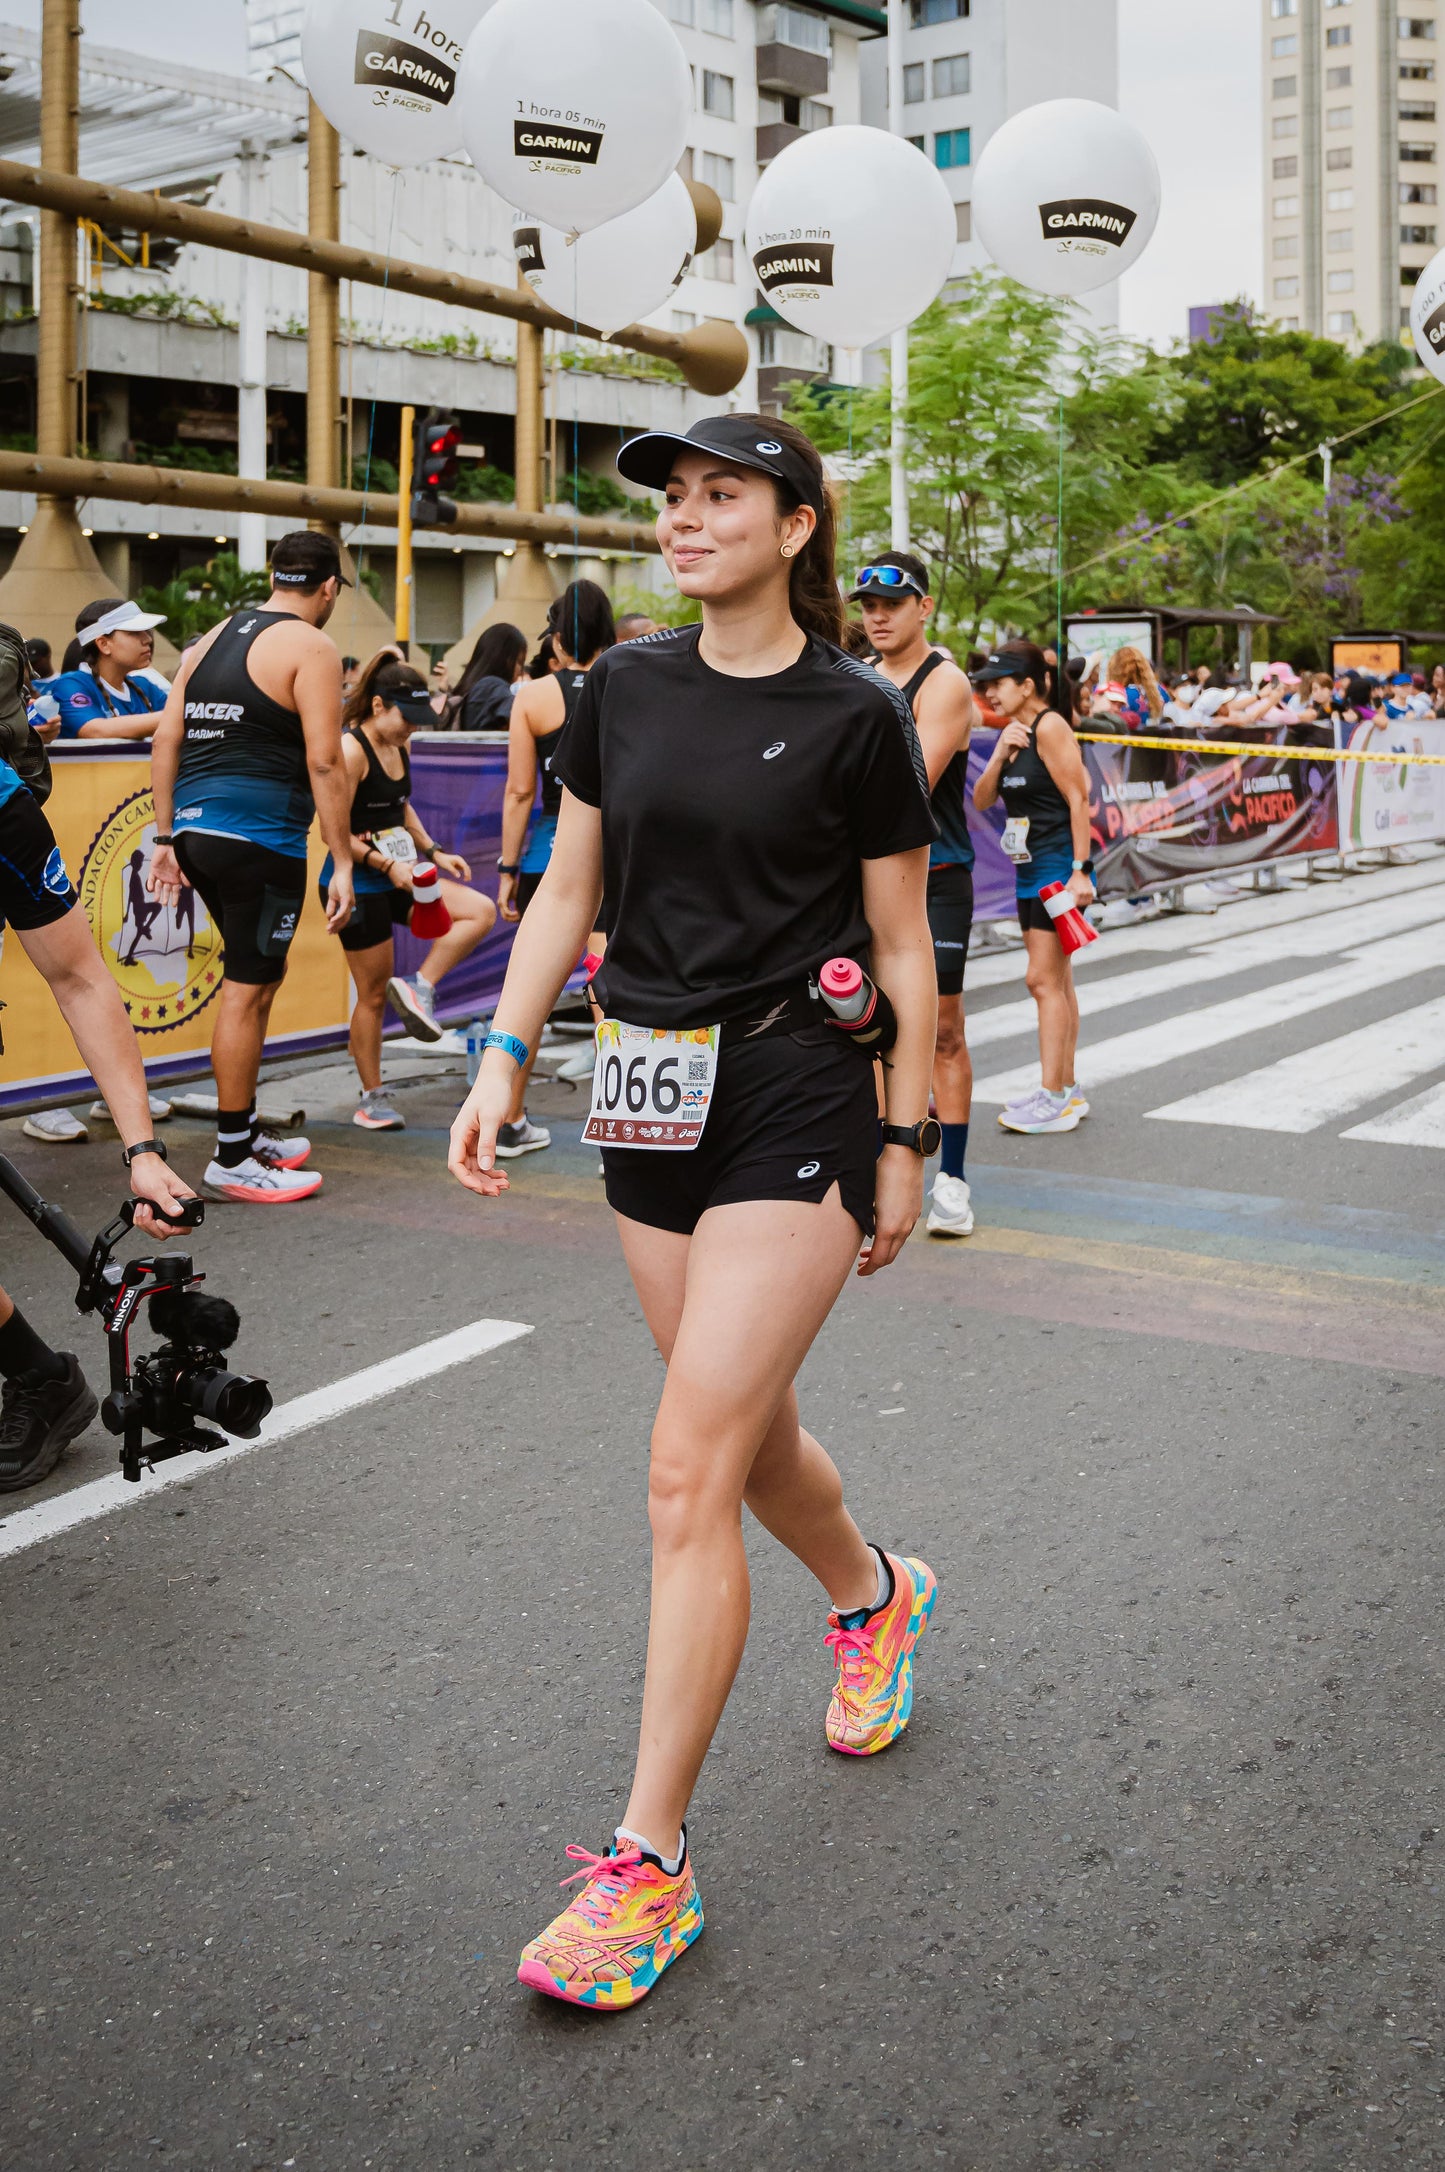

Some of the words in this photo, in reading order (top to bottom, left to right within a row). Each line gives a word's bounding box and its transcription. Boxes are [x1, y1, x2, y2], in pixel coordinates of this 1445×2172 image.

[413, 10, 463, 62] hora
[364, 51, 450, 93] GARMIN
[392, 98, 432, 114] PACIFICO
[517, 100, 525, 113] 1
[530, 102, 561, 119] hora
[565, 110, 581, 122] 05
[583, 116, 606, 130] min
[520, 133, 592, 154] GARMIN
[545, 165, 581, 175] PACIFICO
[1047, 212, 1126, 234] GARMIN
[765, 232, 786, 243] hora
[790, 228, 802, 240] 20
[805, 227, 830, 239] min
[758, 258, 821, 280] GARMIN
[275, 571, 307, 582] PACER
[184, 702, 244, 722] PACER
[1245, 791, 1297, 824] PACIFICO
[84, 820, 124, 935] UNDACIÓN
[511, 1040, 527, 1058] VIP
[111, 1290, 135, 1331] RONIN
